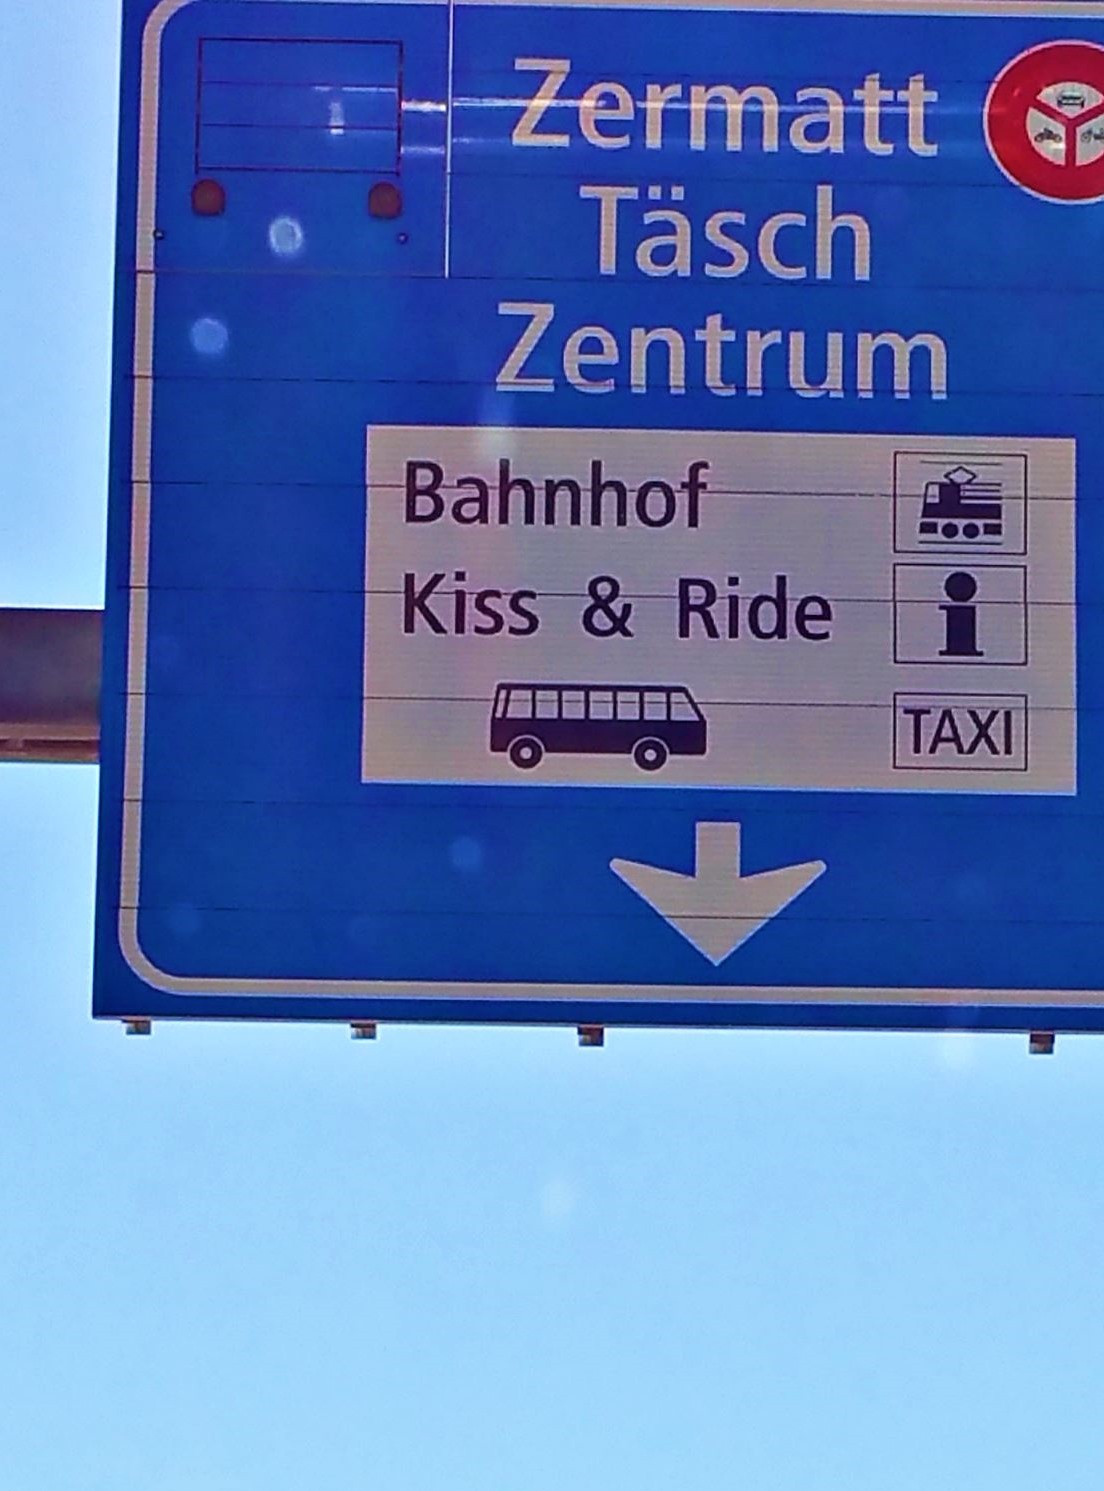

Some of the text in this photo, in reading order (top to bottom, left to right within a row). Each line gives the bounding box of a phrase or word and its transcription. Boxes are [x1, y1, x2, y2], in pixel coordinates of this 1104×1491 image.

[511, 56, 939, 158] Zermatt
[579, 183, 872, 283] Täsch
[495, 301, 950, 402] Zentrum
[403, 458, 711, 530] Bahnhof
[403, 571, 835, 642] Kiss & Ride
[903, 707, 1015, 758] TAXI
